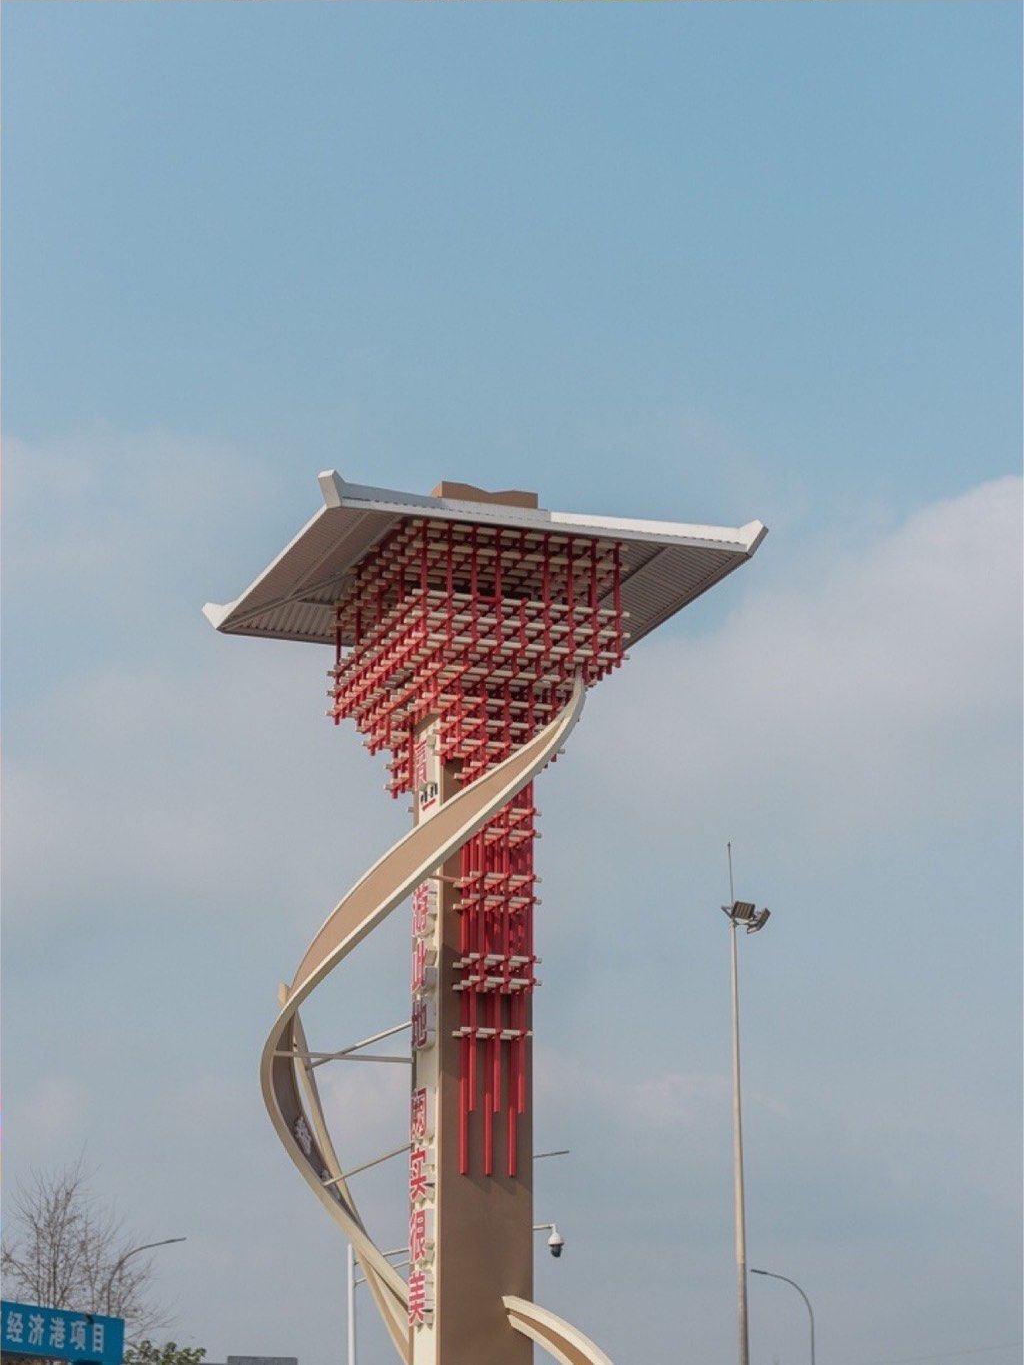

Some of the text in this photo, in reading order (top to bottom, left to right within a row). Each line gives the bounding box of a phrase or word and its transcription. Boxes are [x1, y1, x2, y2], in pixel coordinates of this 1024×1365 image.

[5, 1311, 104, 1354] 经济港项目
